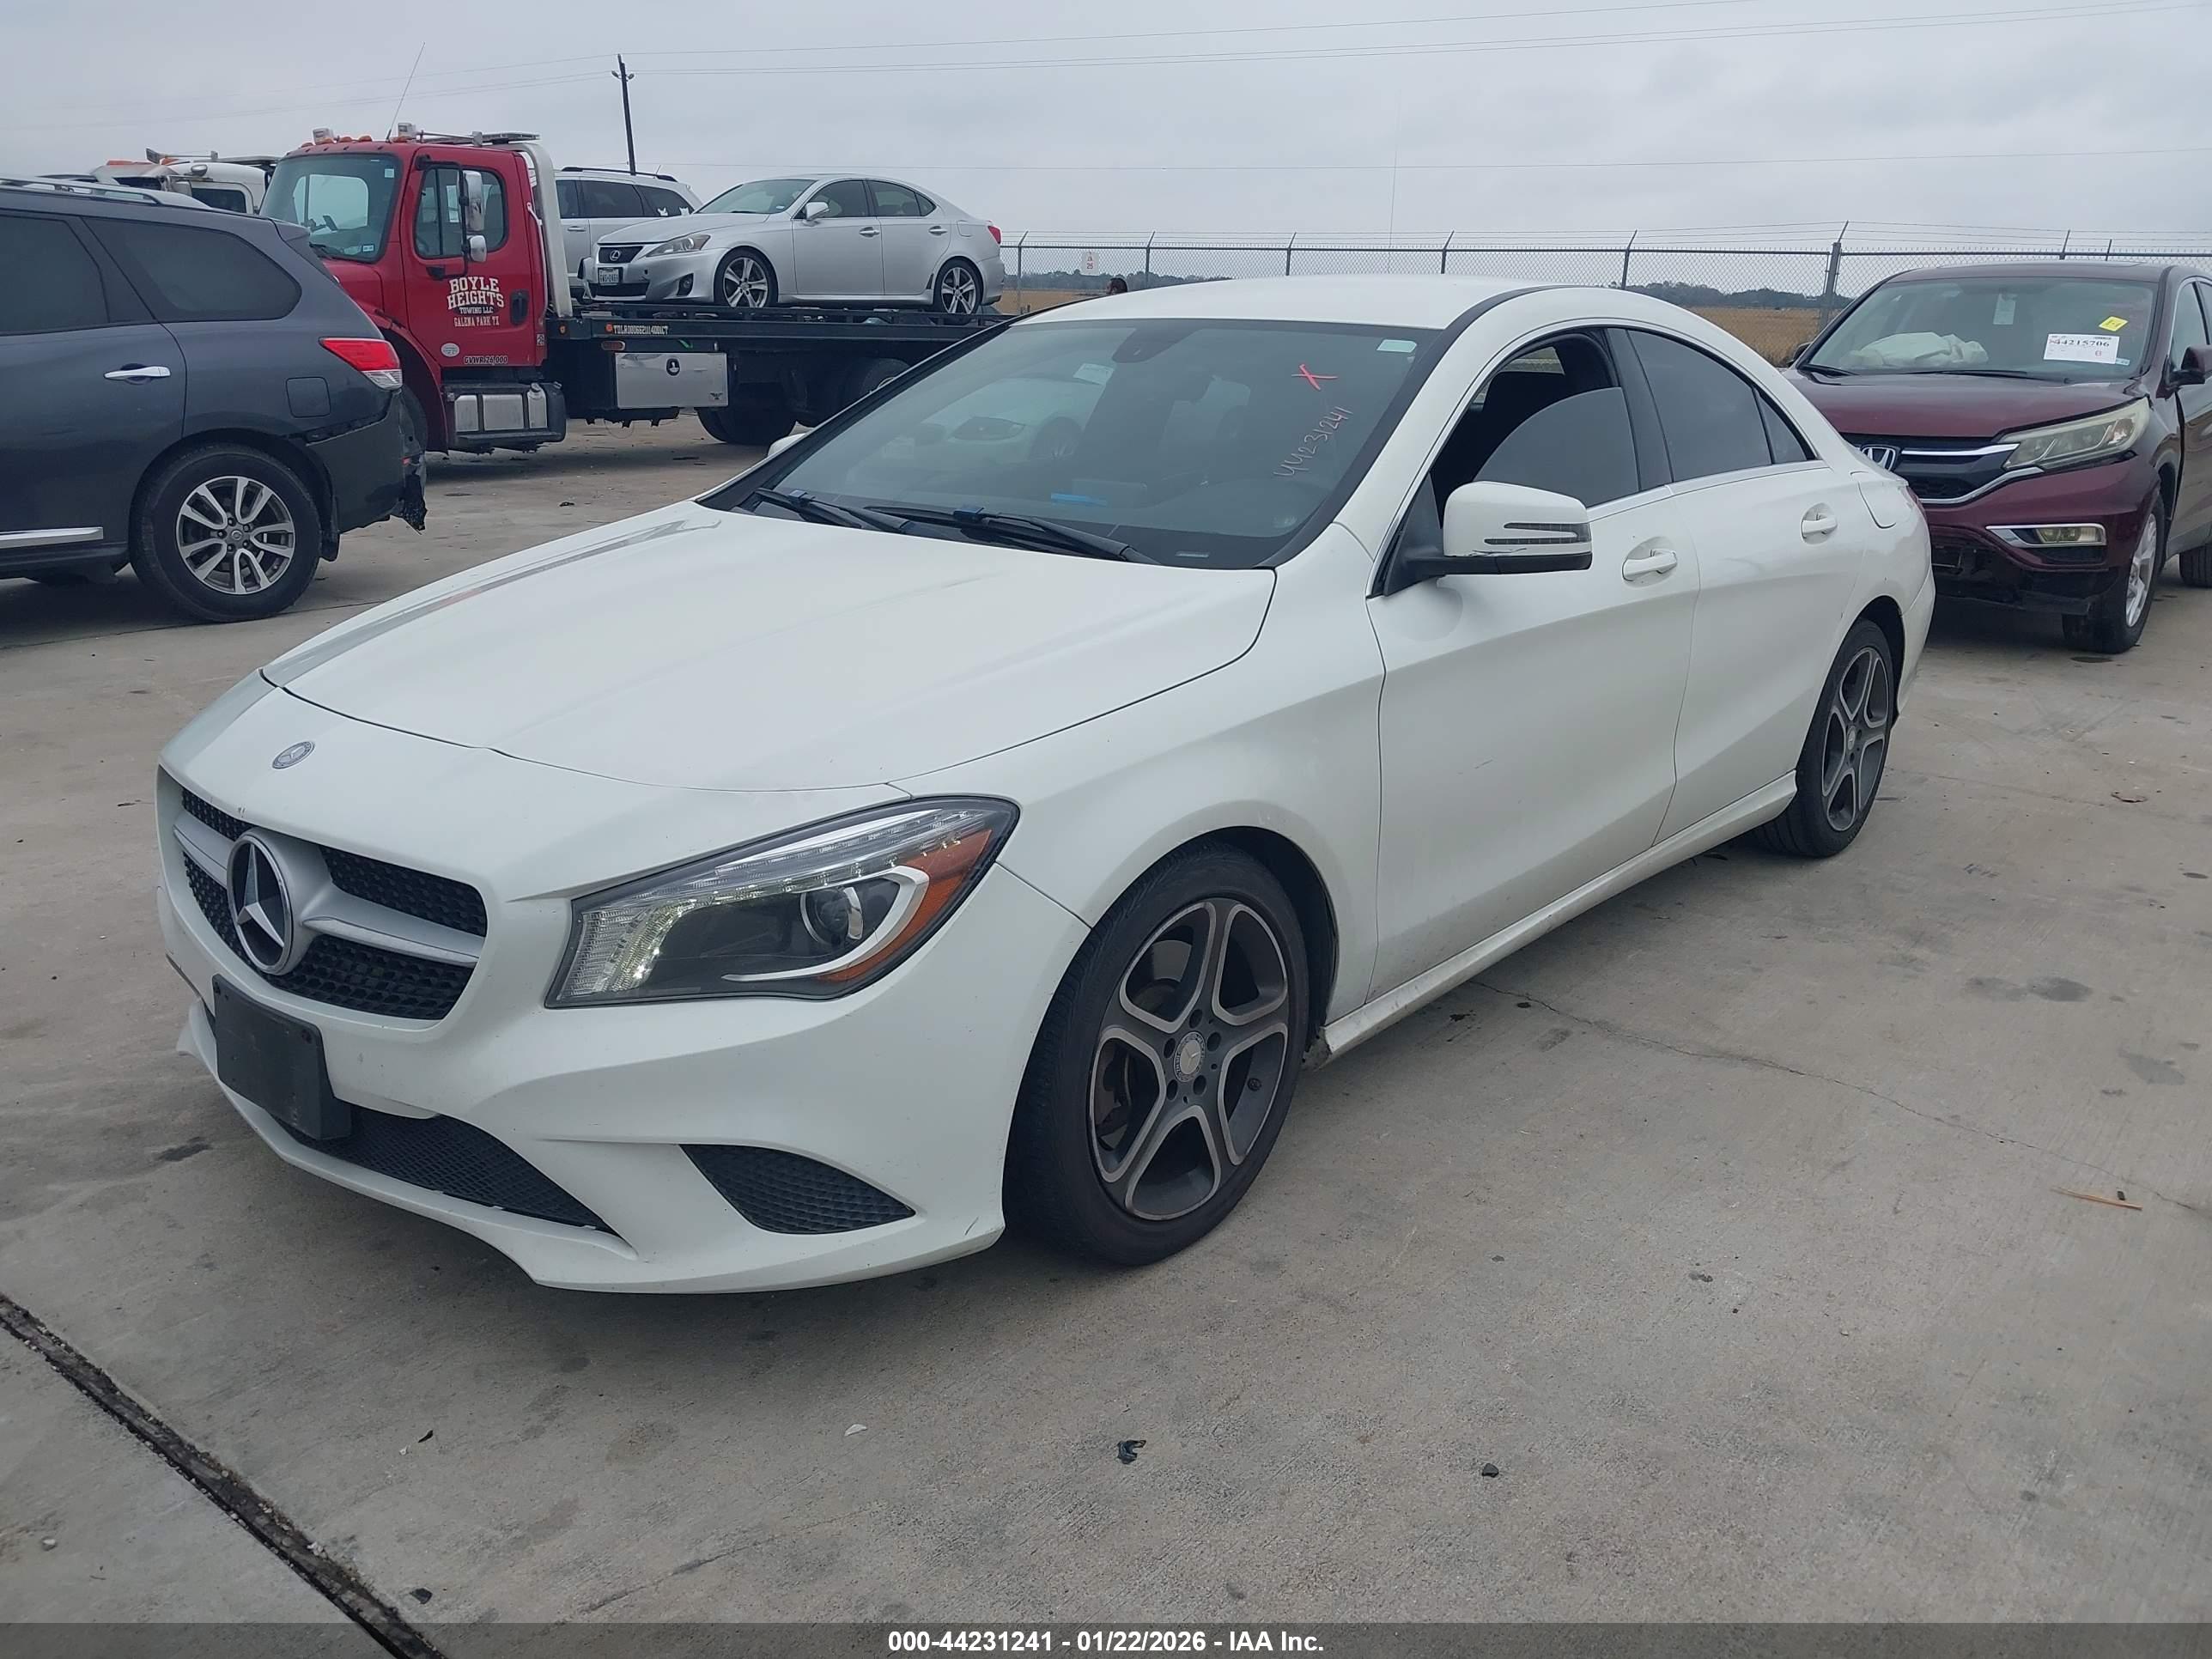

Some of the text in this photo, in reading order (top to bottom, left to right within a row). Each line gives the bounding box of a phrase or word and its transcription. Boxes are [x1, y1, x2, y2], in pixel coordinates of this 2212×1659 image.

[449, 276, 500, 294] BOYLE
[447, 291, 505, 309] HEIGHTS
[454, 316, 500, 327] GALENA PARK TX
[1273, 406, 1353, 477] 44231241
